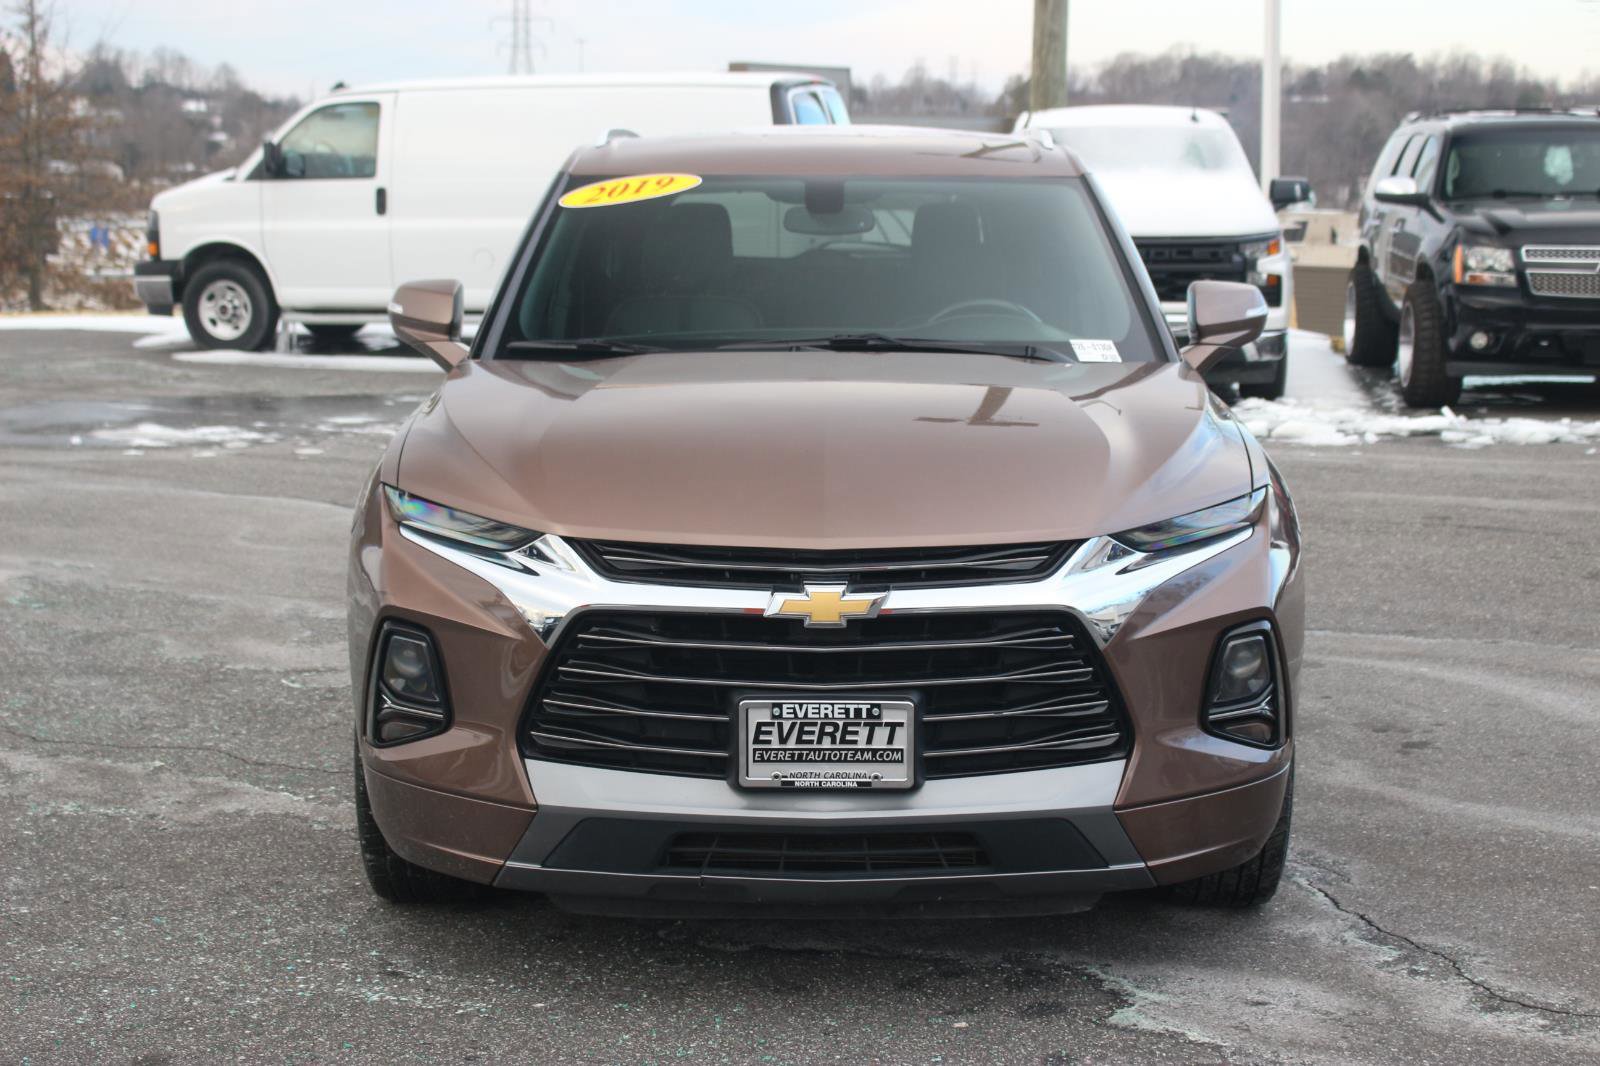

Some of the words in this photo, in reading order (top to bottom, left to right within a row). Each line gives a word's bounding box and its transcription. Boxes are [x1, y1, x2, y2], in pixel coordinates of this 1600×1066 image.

[585, 176, 675, 203] 2019
[782, 704, 871, 719] EVERETT
[752, 721, 905, 745] EVERETT
[754, 750, 902, 761] EVERETTAUTOTEAM.COM
[789, 771, 821, 779] NORTH
[823, 771, 867, 779] CAROLINA
